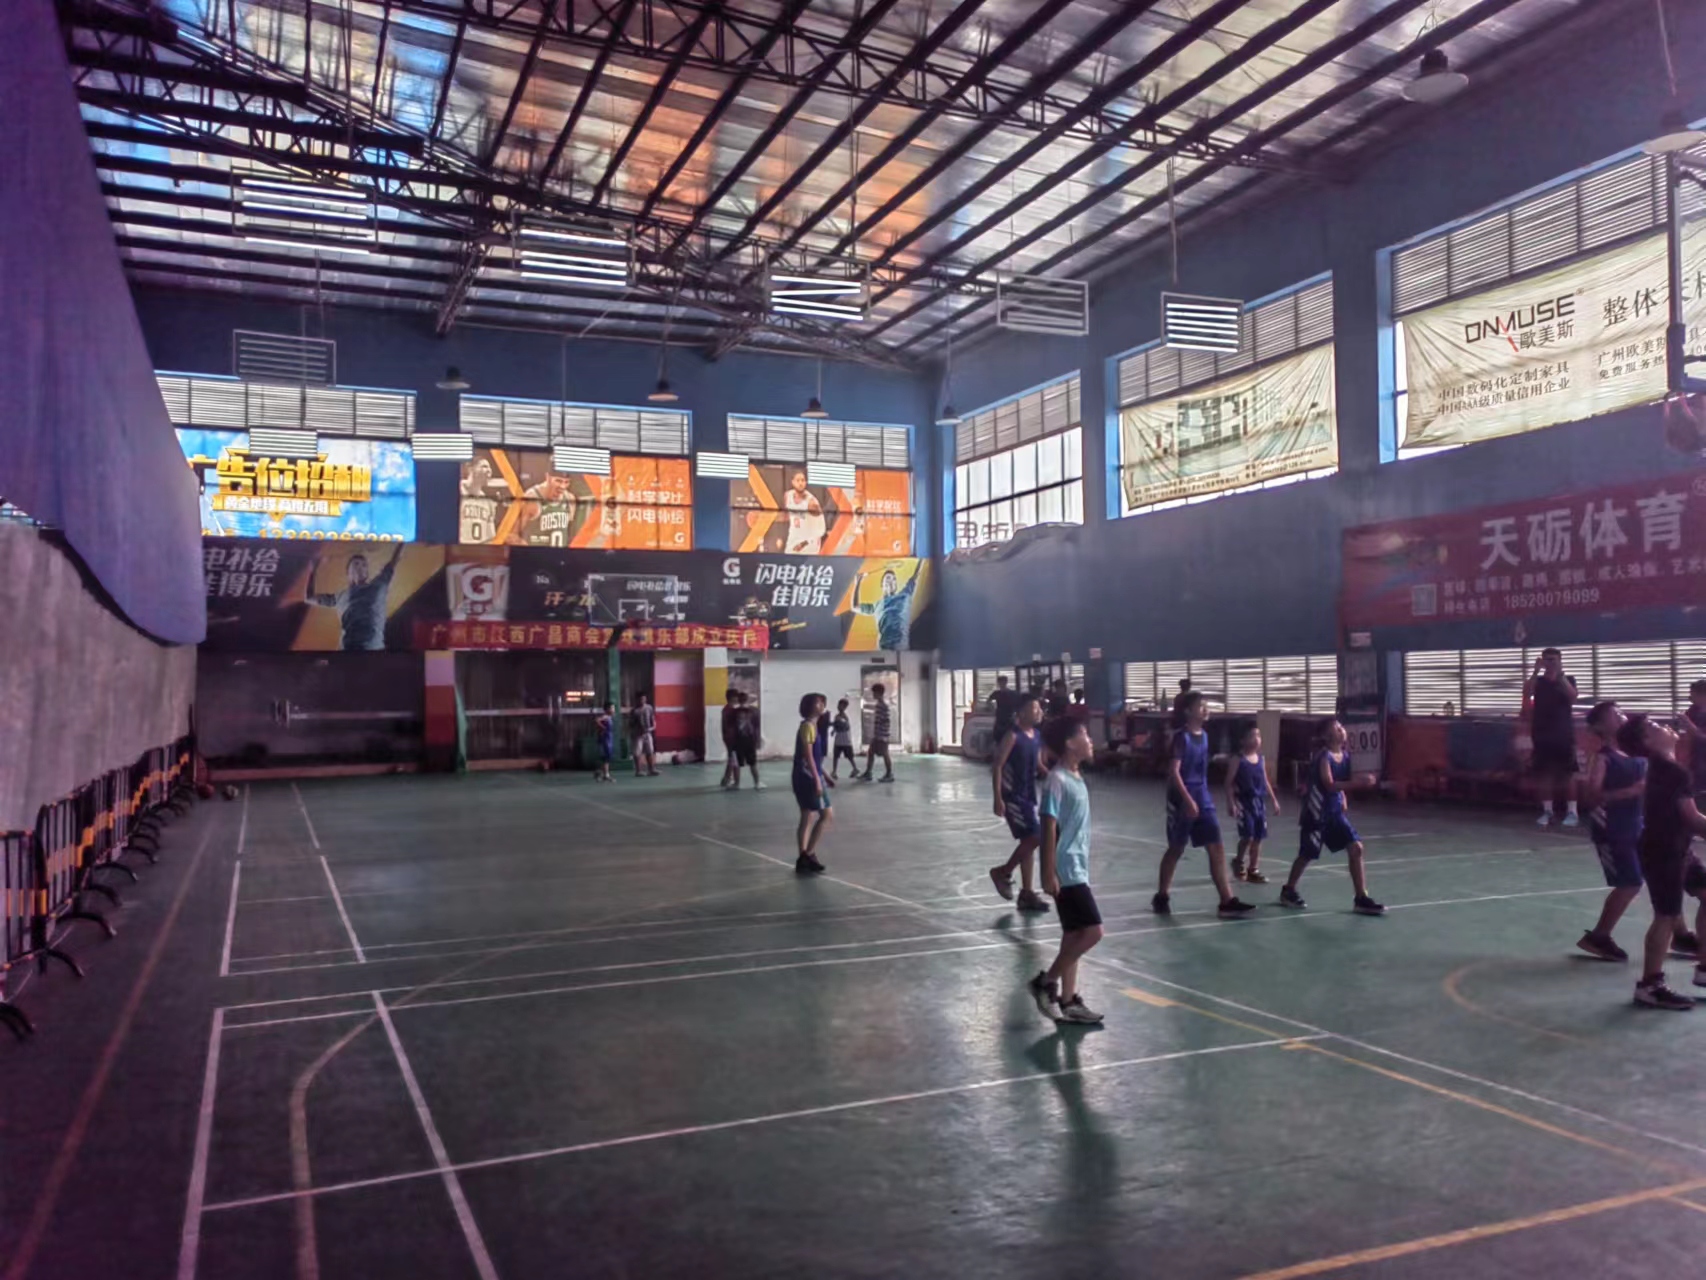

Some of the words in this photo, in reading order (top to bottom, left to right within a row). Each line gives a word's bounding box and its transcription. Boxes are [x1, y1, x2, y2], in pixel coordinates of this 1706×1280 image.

[1520, 318, 1575, 350] 歐美斯
[1438, 360, 1570, 401] 中国数码化定制家具
[540, 511, 569, 531] BOSTO
[1480, 489, 1689, 570] 天砺体育
[722, 557, 741, 578] G
[754, 562, 835, 586] 闪电补给
[462, 567, 494, 602] G
[771, 585, 831, 607] 佳得乐
